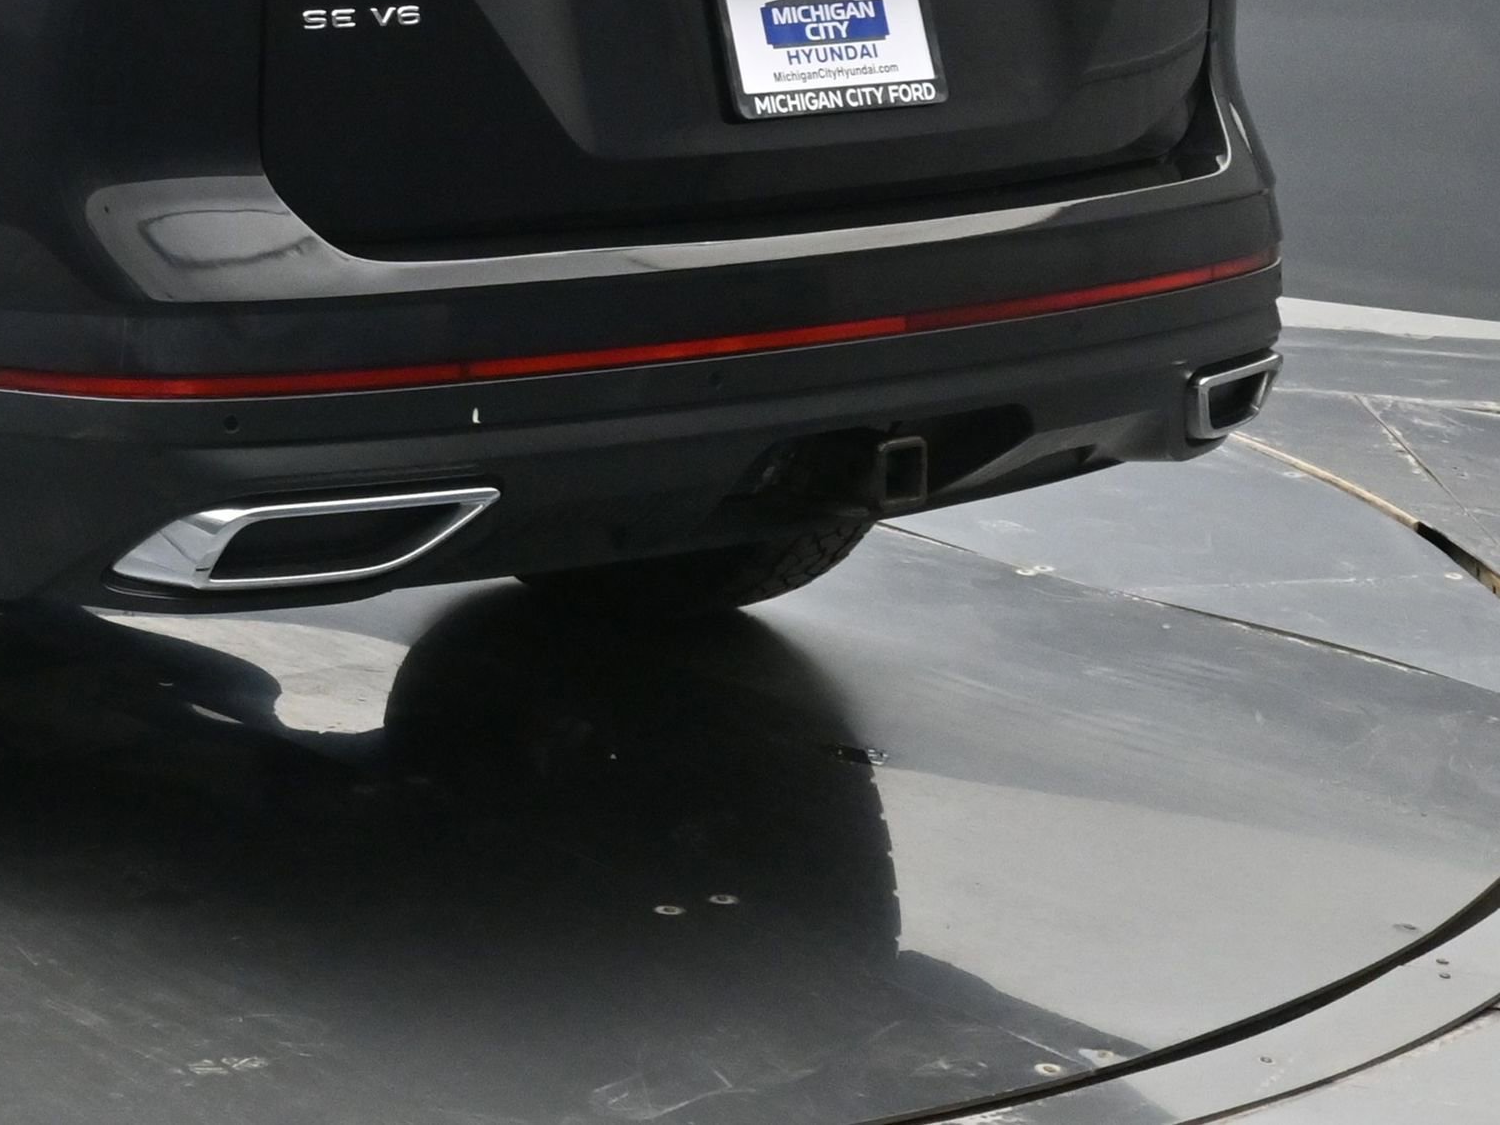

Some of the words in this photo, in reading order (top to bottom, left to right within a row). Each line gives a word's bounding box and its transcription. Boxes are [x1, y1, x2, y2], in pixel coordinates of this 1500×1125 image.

[302, 8, 356, 29] SE
[370, 5, 421, 26] V6
[771, 1, 875, 25] MICHIGAN
[805, 21, 849, 41] CITY
[787, 43, 879, 65] HYUNDAI
[773, 63, 899, 83] MichiganCityHyundai.com
[754, 90, 844, 115] MICHIGAN
[846, 86, 884, 107] CITY
[888, 82, 936, 104] FORD
